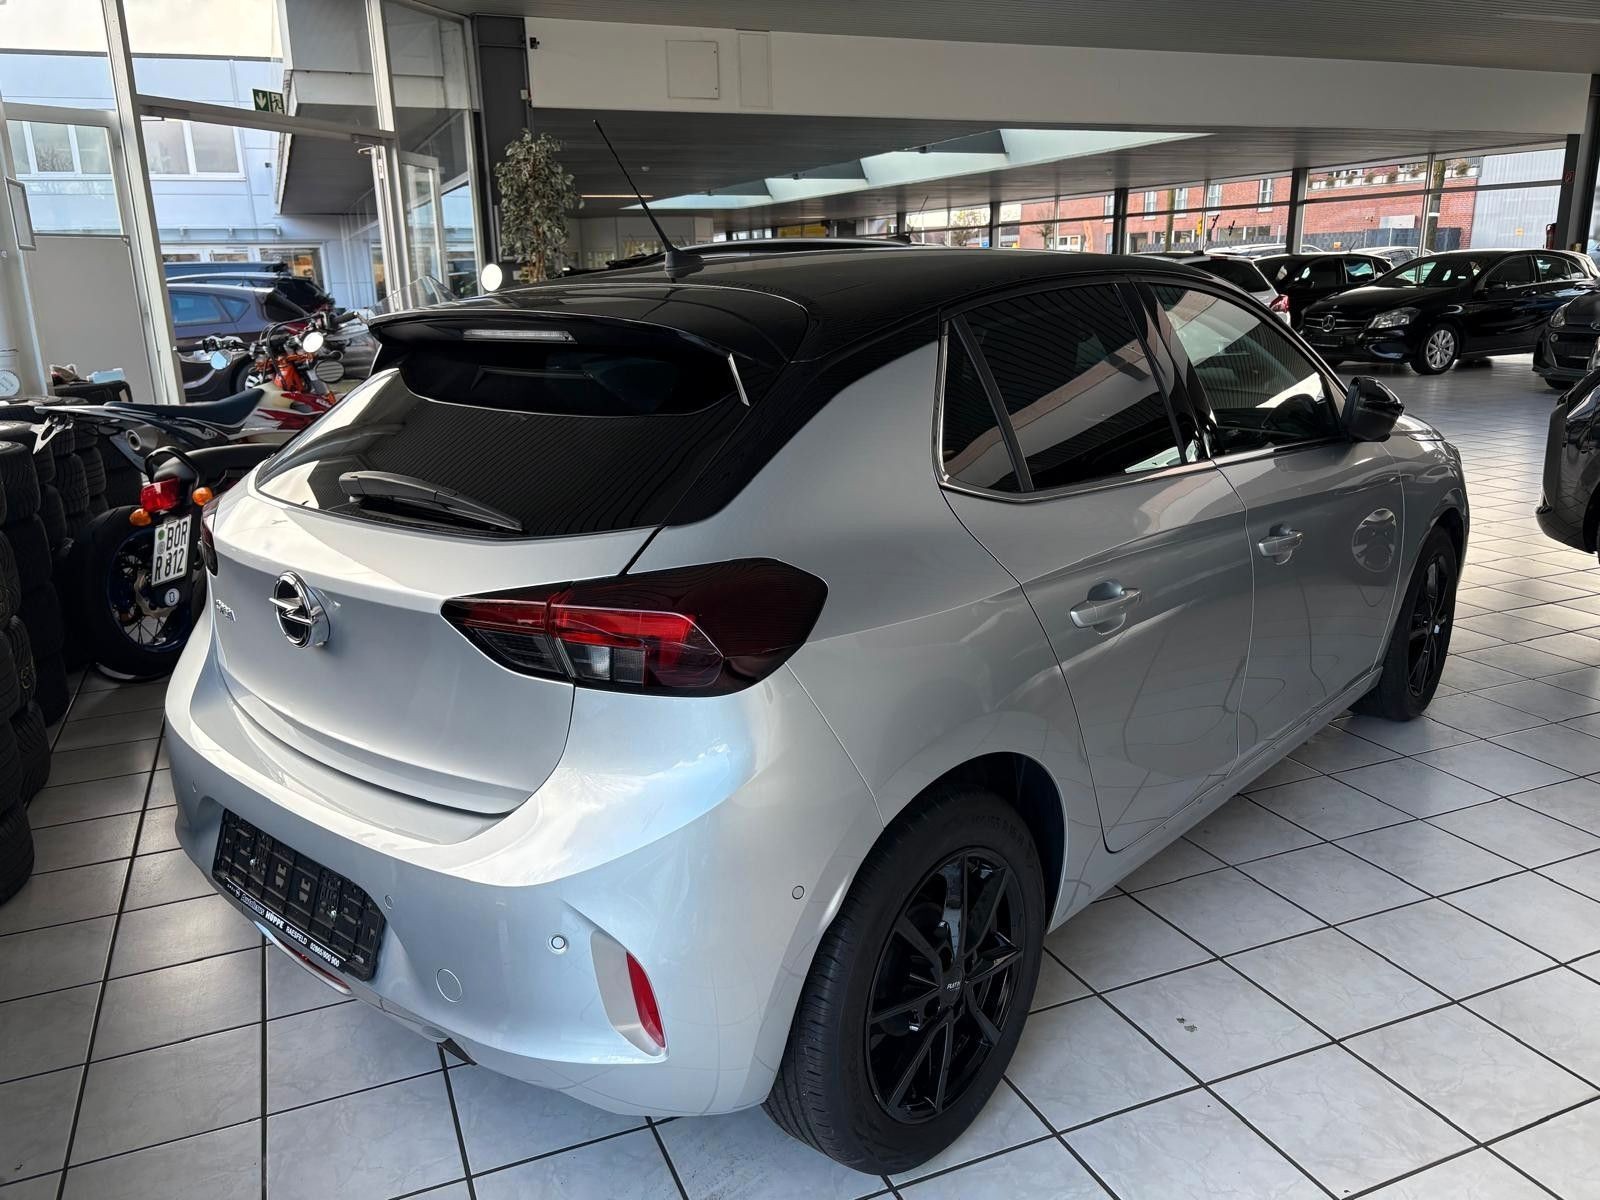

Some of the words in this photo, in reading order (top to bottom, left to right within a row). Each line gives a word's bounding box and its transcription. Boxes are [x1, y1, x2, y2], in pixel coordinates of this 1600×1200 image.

[167, 521, 188, 551] BOR
[155, 557, 162, 581] R
[165, 548, 185, 577] 812
